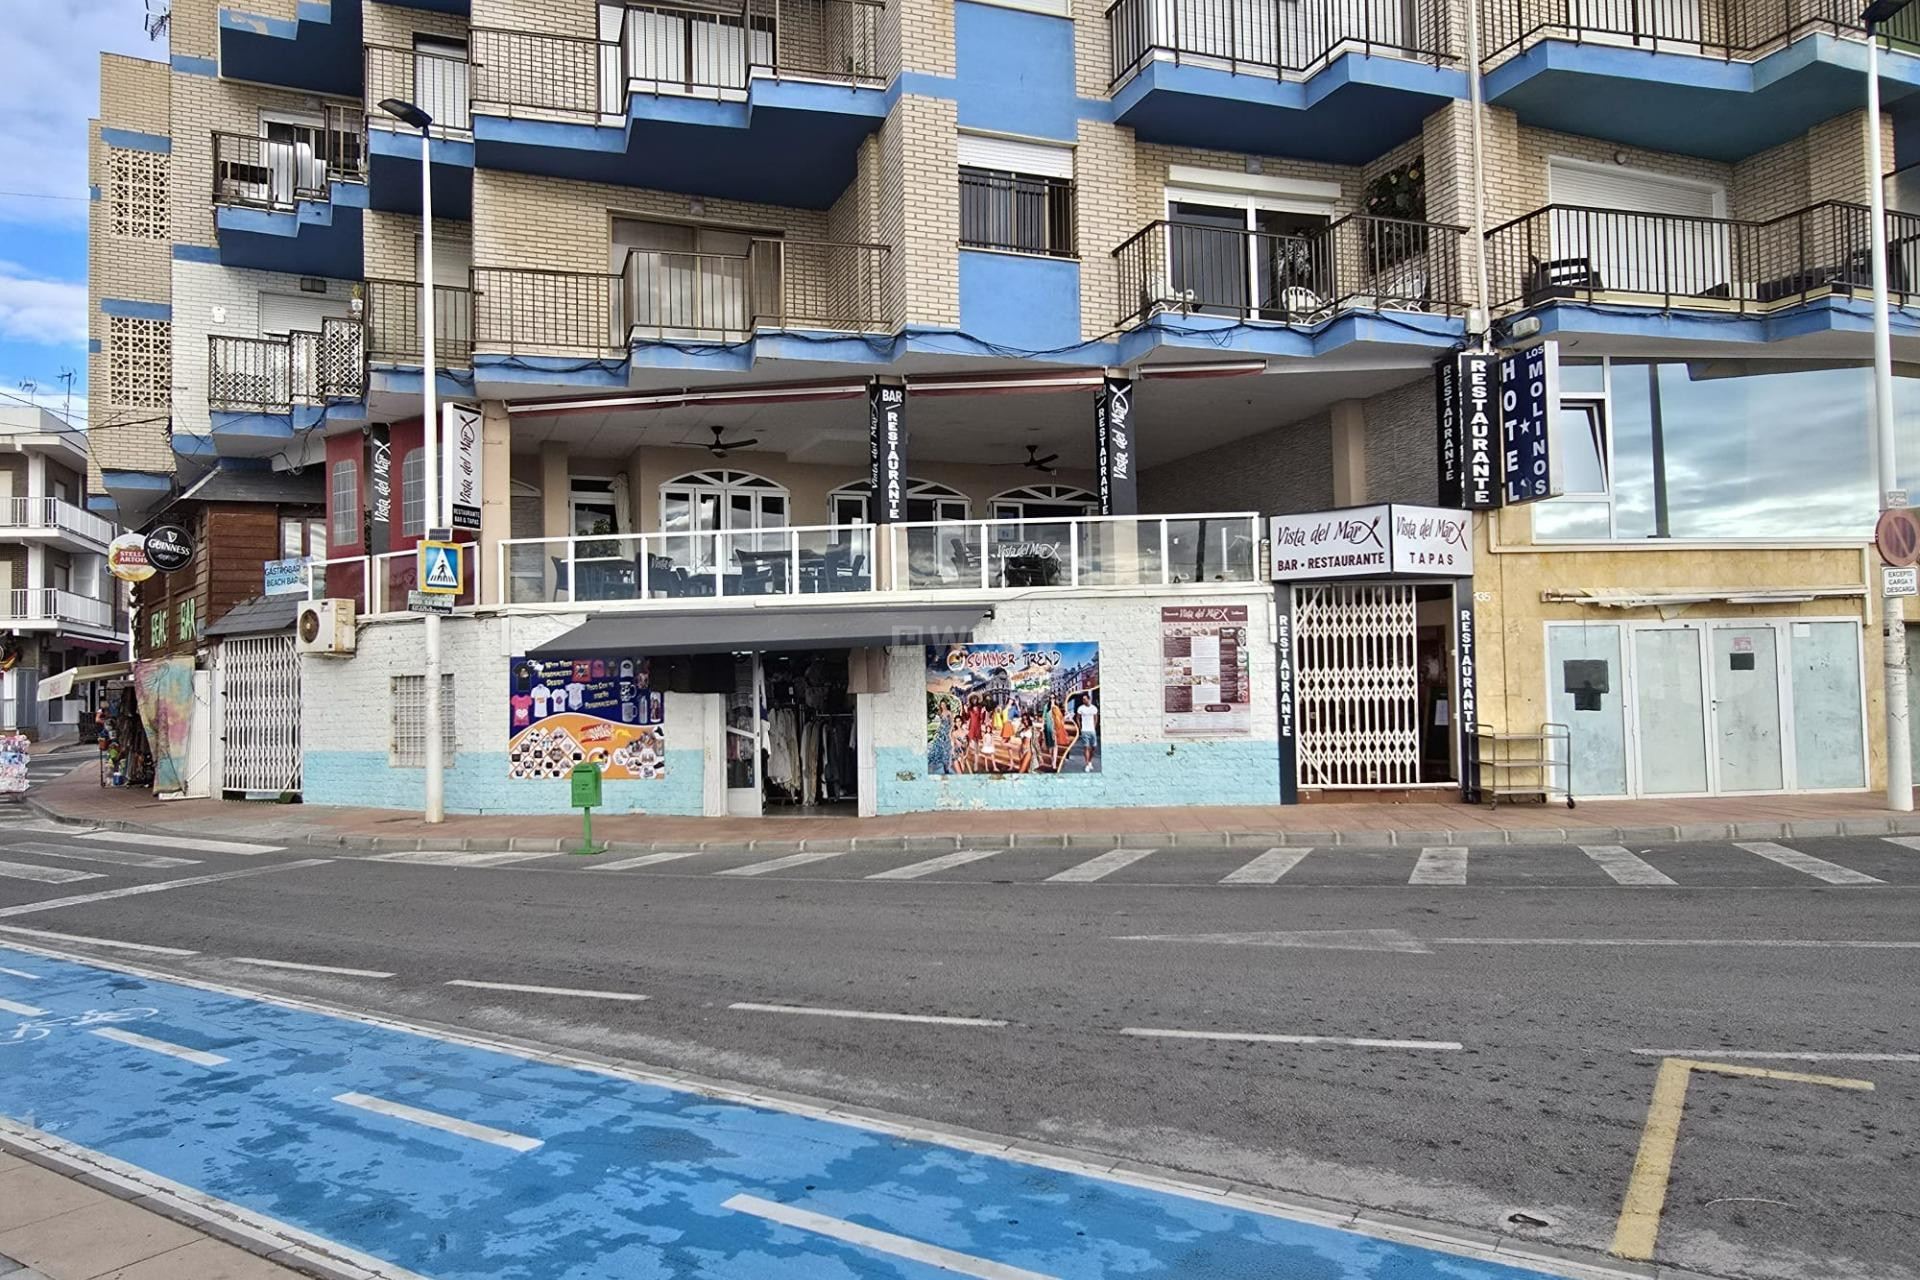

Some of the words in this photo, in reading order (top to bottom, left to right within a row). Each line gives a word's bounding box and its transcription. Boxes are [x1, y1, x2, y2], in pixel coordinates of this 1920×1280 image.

[1526, 346, 1544, 359] LOS
[882, 389, 903, 402] BAR
[1111, 401, 1126, 429] Mar
[1443, 364, 1454, 481] RESTAURANTE
[1111, 428, 1128, 450] del
[1470, 360, 1490, 503] RESTAURANTE
[1501, 359, 1519, 502] HOTEL
[1528, 360, 1547, 495] MOLINOS
[460, 431, 475, 457] Mar
[374, 454, 391, 478] Mar
[460, 456, 473, 476] del
[887, 411, 900, 519] RESTAURANTE
[1098, 408, 1109, 515] RESTAURANTE
[1113, 452, 1129, 480] Vista
[374, 478, 391, 496] del
[871, 463, 879, 489] Vista
[460, 479, 473, 504] Vista
[374, 499, 391, 522] Vista
[453, 508, 480, 518] RESTAURANTE
[454, 515, 463, 523] BAR
[1278, 527, 1306, 546] Vista
[1311, 523, 1331, 545] del
[1333, 520, 1361, 542] Mar
[1397, 516, 1417, 539] Vista
[1420, 518, 1434, 540] del
[1435, 519, 1454, 538] Mar
[148, 539, 190, 556] GUINNESS
[997, 544, 1016, 558] Vista
[1016, 543, 1030, 557] del
[1409, 552, 1454, 565] TAPAS
[1277, 559, 1298, 571] BAR
[1307, 552, 1385, 569] RESTAURANTE
[966, 651, 1016, 668] SUMMER
[1021, 651, 1060, 669] TREND
[1460, 610, 1474, 733] RESTAURANTE
[1279, 615, 1291, 736] RESTAURANTE
